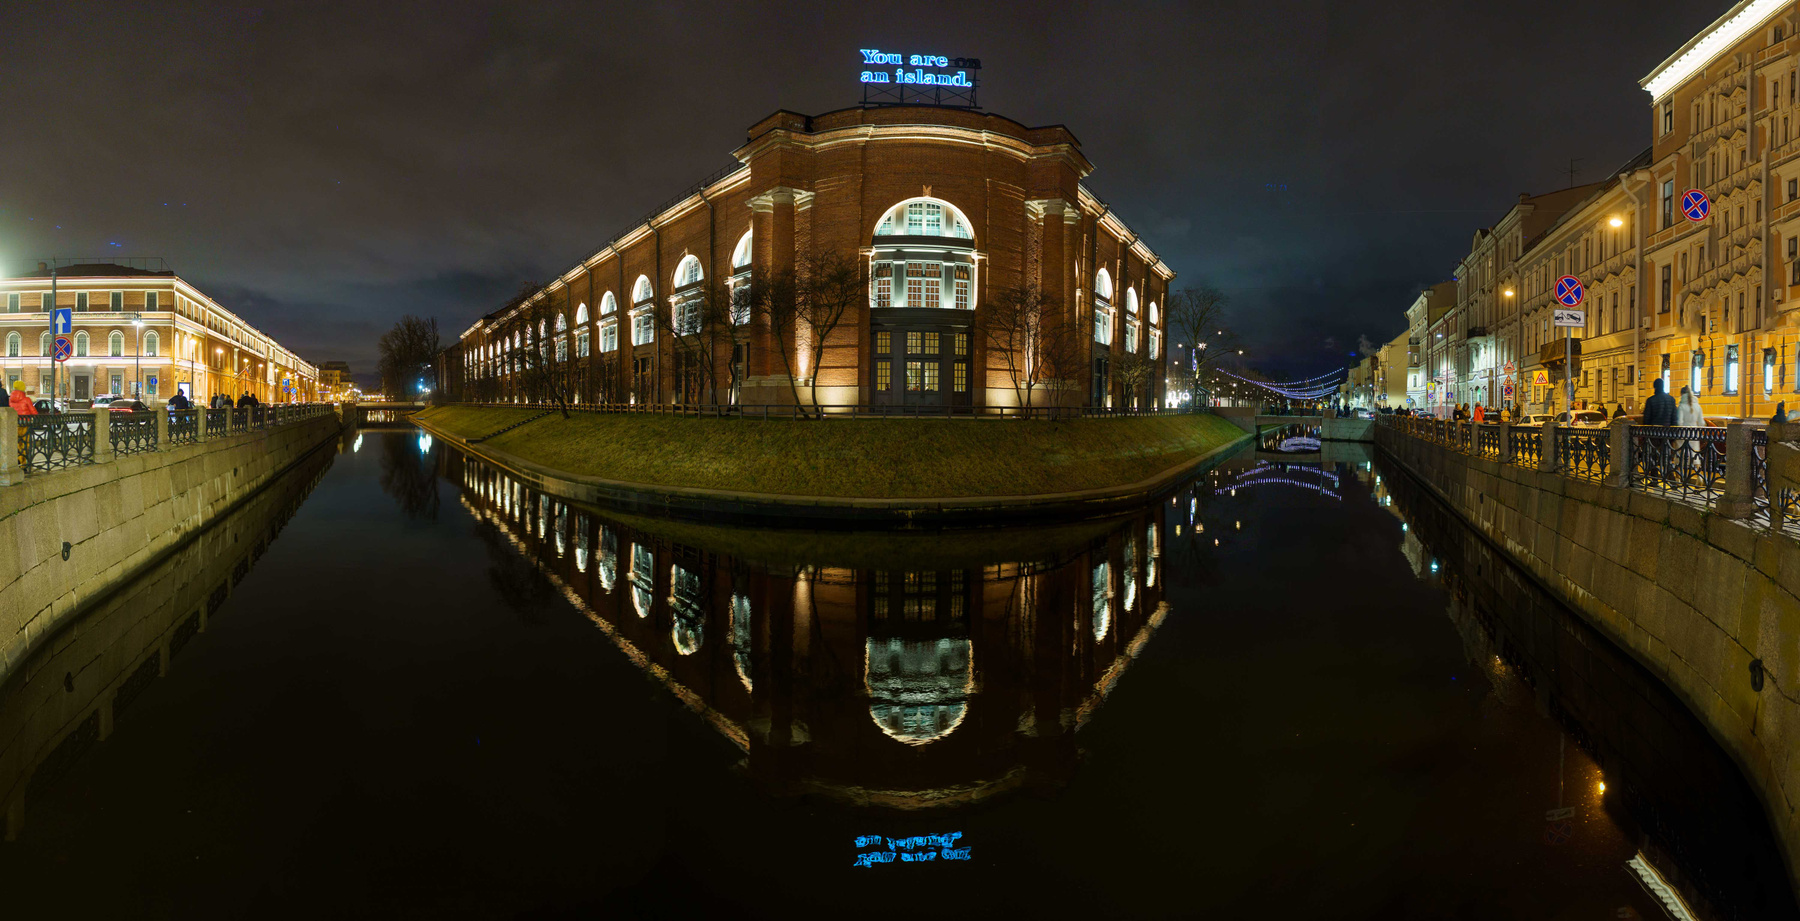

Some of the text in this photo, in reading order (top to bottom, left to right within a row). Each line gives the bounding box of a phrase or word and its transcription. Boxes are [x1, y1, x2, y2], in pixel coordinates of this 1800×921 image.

[860, 49, 903, 65] You
[909, 54, 948, 67] are
[860, 68, 973, 88] an island.
